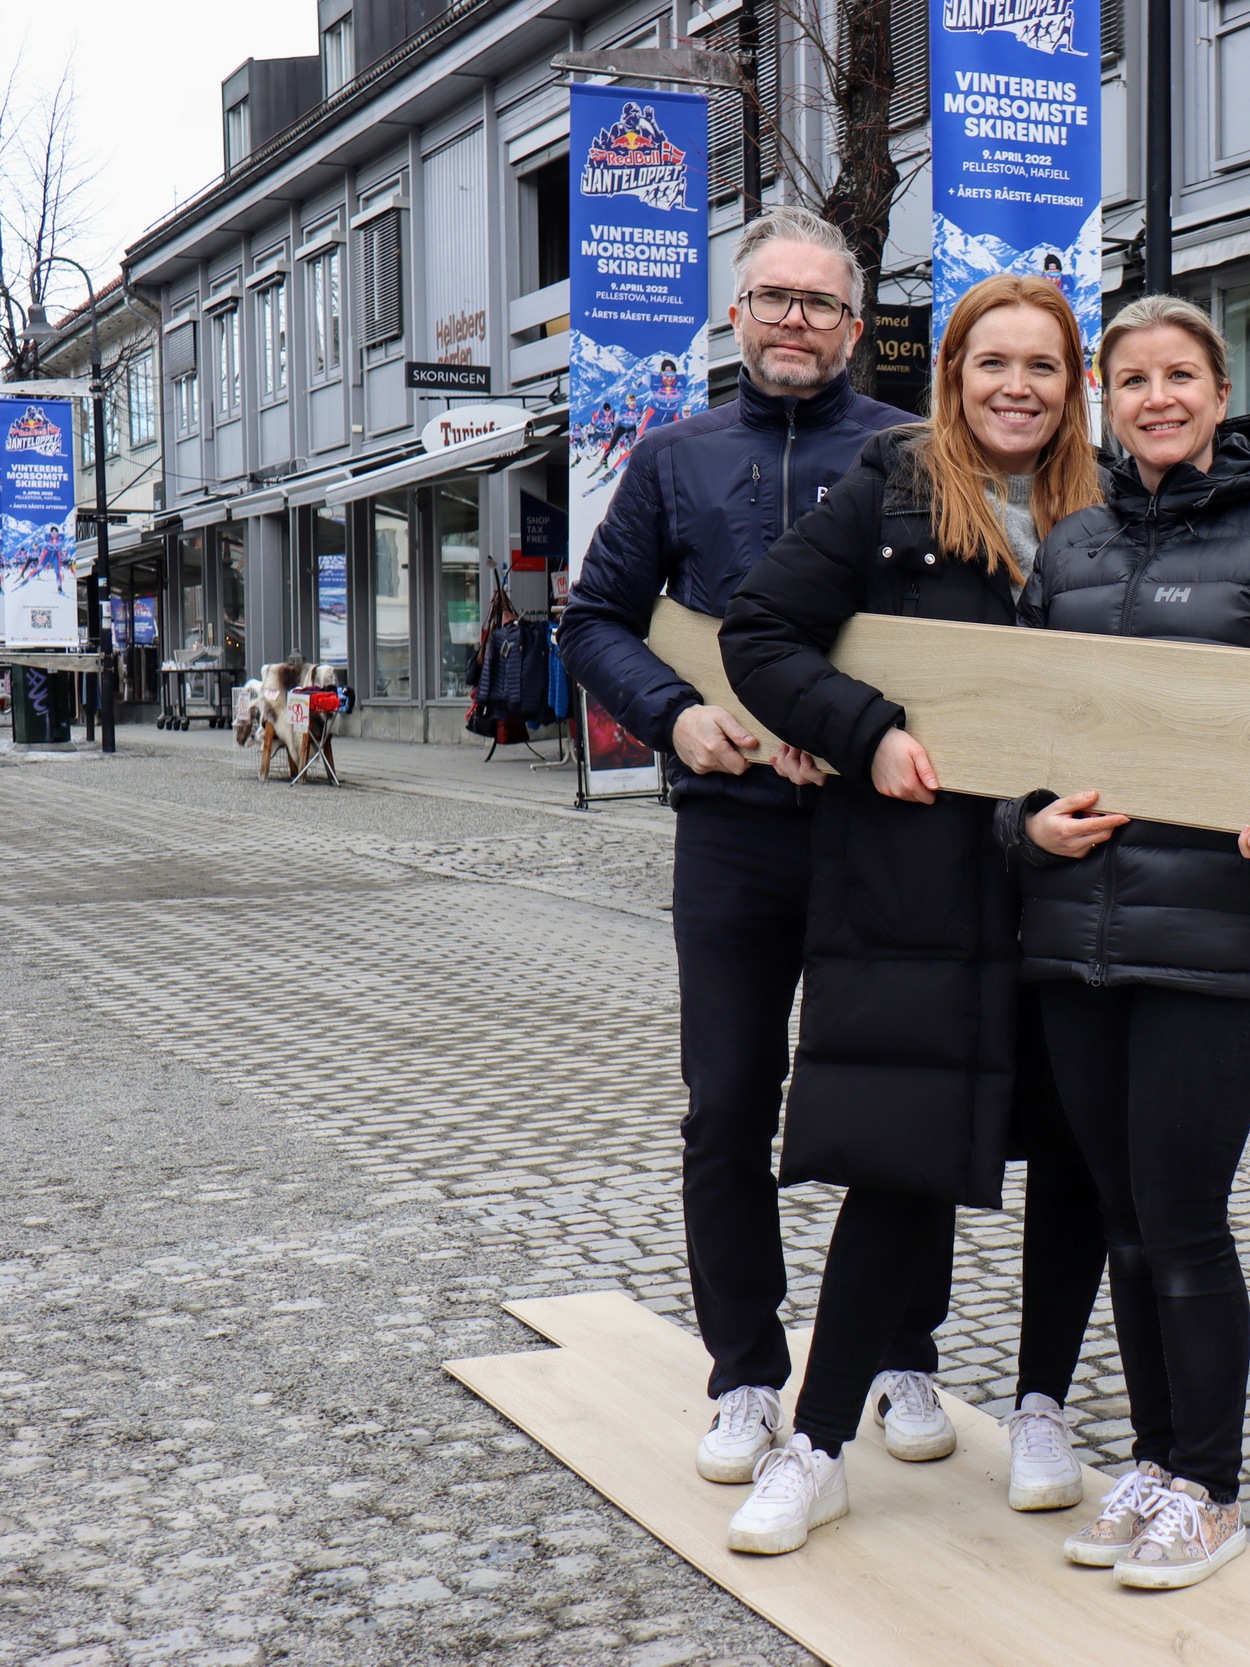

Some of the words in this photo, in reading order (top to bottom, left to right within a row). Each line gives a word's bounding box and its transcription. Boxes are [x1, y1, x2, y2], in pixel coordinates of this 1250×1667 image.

[955, 71, 1077, 102] VINTERENS
[944, 93, 1088, 126] MORSOMSTE
[964, 117, 1068, 146] SKIRENN!
[606, 150, 633, 166] Red
[635, 149, 661, 165] Bull
[982, 149, 992, 160] 9.
[994, 151, 1024, 163] APRIL
[1025, 154, 1052, 166] 2022
[582, 165, 683, 193] JANTELOPPET
[962, 161, 1029, 178] PELLESTOVA,
[1030, 168, 1070, 180] HAFJELL
[957, 184, 992, 199] ÅRETS
[994, 186, 1032, 203] RÅESTE
[1033, 195, 1084, 207] AFTERSKI!
[590, 224, 689, 247] VINTERENS
[581, 240, 698, 263] MORSOMSTE
[597, 258, 681, 279] SKIRENN!
[610, 282, 618, 291] 9.
[620, 283, 644, 292] APRIL
[645, 284, 668, 294] 2022
[595, 290, 649, 303] PELLESTOVA,
[650, 296, 684, 304] HAFJELL
[591, 307, 618, 319] ÅRETS
[620, 310, 651, 322] RÅESTE
[652, 315, 695, 324] AFTERSKI!
[436, 310, 486, 350] Helleberg
[413, 370, 486, 385] SKORINGEN
[440, 421, 501, 446] Turistf
[6, 471, 69, 481] MORSOMSTE
[11, 464, 63, 473] VINTERENS
[15, 480, 60, 489] SKIRENN!
[526, 516, 551, 525] SHOP
[526, 526, 544, 534] TAX
[526, 535, 549, 543] FREE
